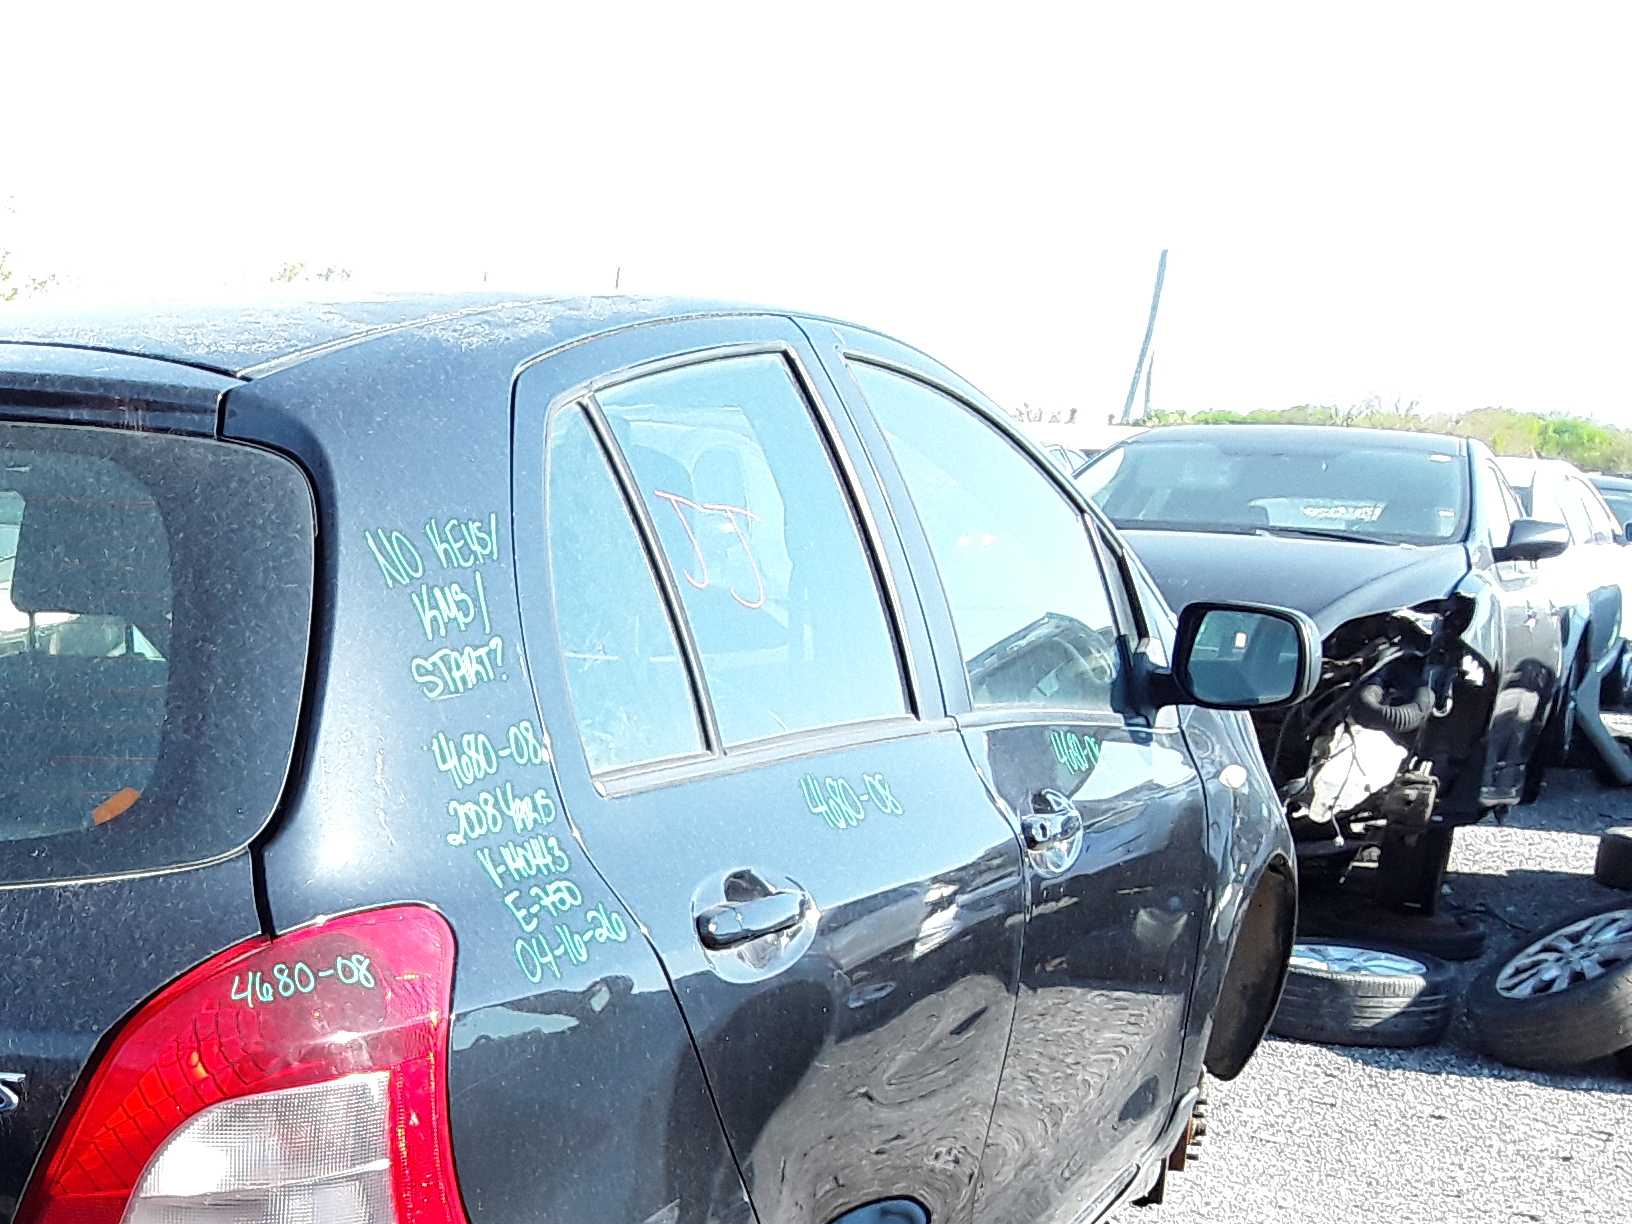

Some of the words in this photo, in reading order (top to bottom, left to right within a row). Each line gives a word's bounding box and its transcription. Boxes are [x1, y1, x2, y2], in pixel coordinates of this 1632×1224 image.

[364, 527, 424, 588] NO
[411, 635, 509, 699] START?
[431, 719, 542, 790] 4680-08
[446, 790, 504, 847] 2008
[799, 772, 905, 829] 4680-08
[514, 902, 628, 984] 04-16-26
[230, 954, 376, 1009] 4680-08
